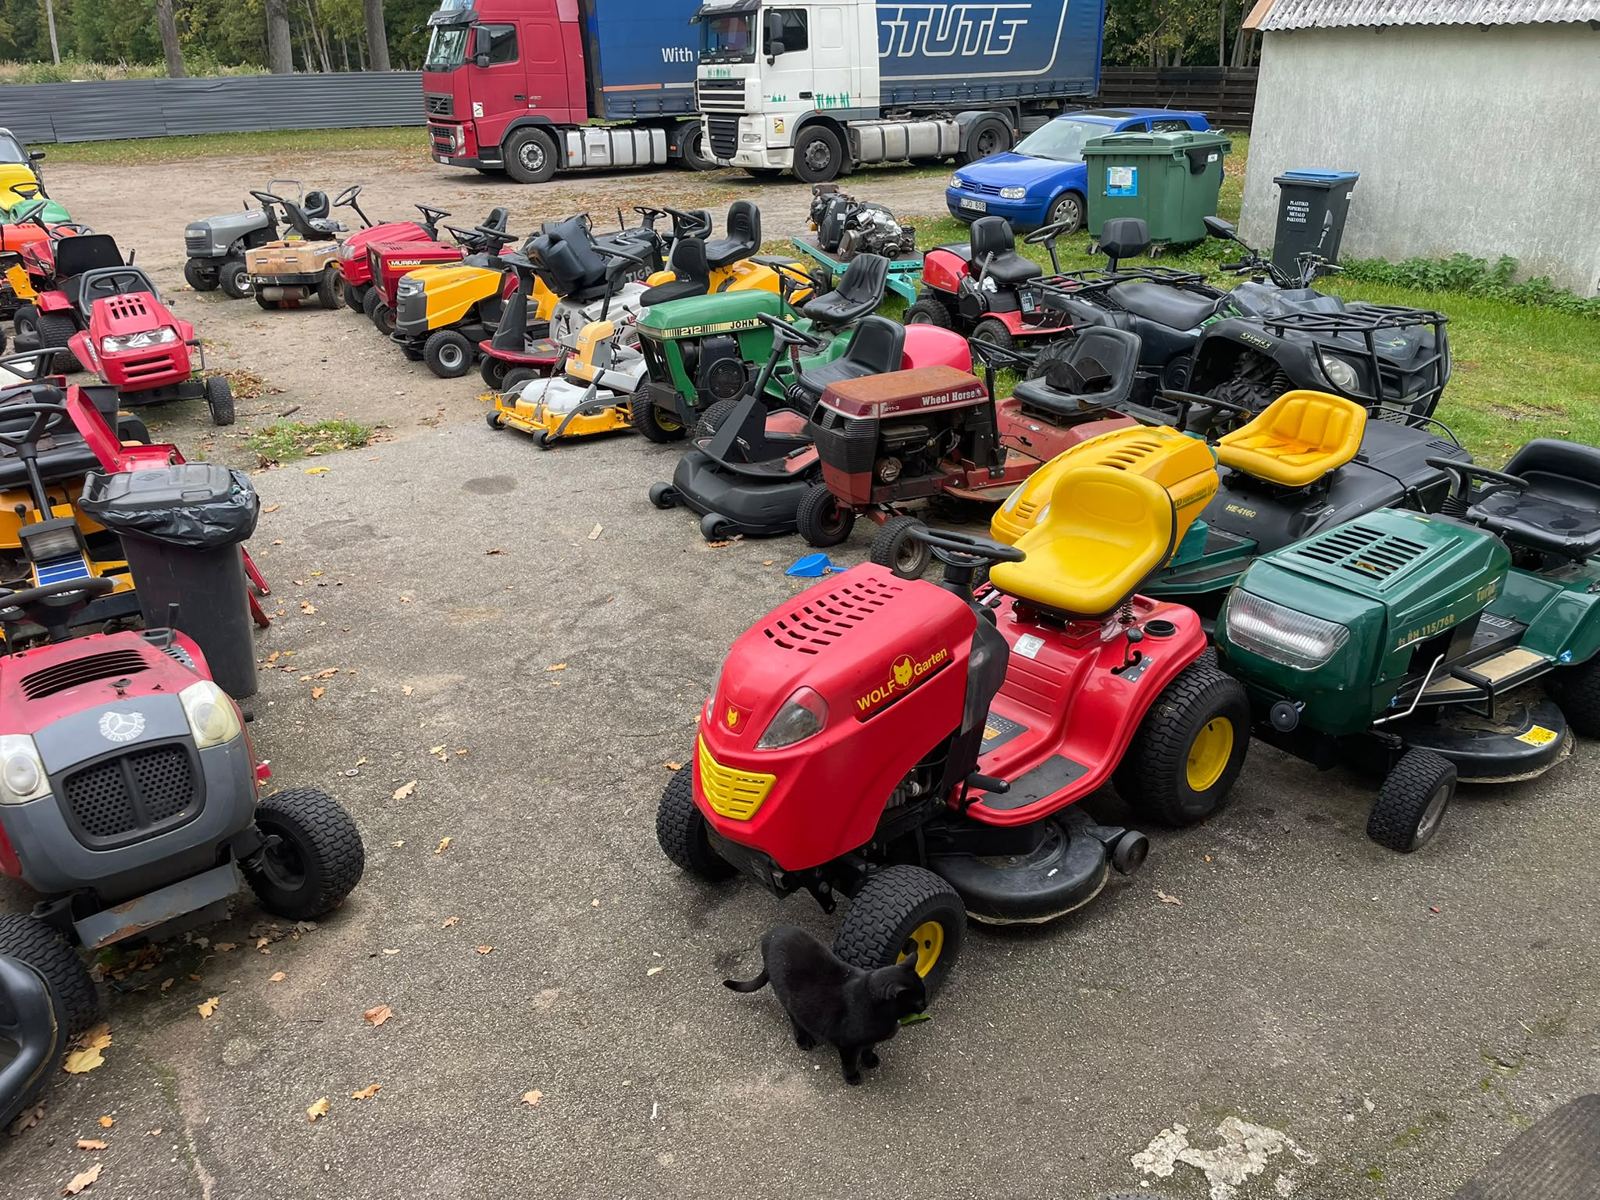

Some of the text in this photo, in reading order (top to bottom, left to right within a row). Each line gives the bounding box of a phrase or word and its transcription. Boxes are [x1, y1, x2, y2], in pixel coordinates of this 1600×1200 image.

[661, 47, 694, 63] With
[625, 265, 653, 283] TIGA
[680, 325, 703, 336] 212
[730, 318, 755, 329] JOHN
[921, 390, 975, 406] Wheel Horse
[856, 647, 948, 711] WOLF Garten
